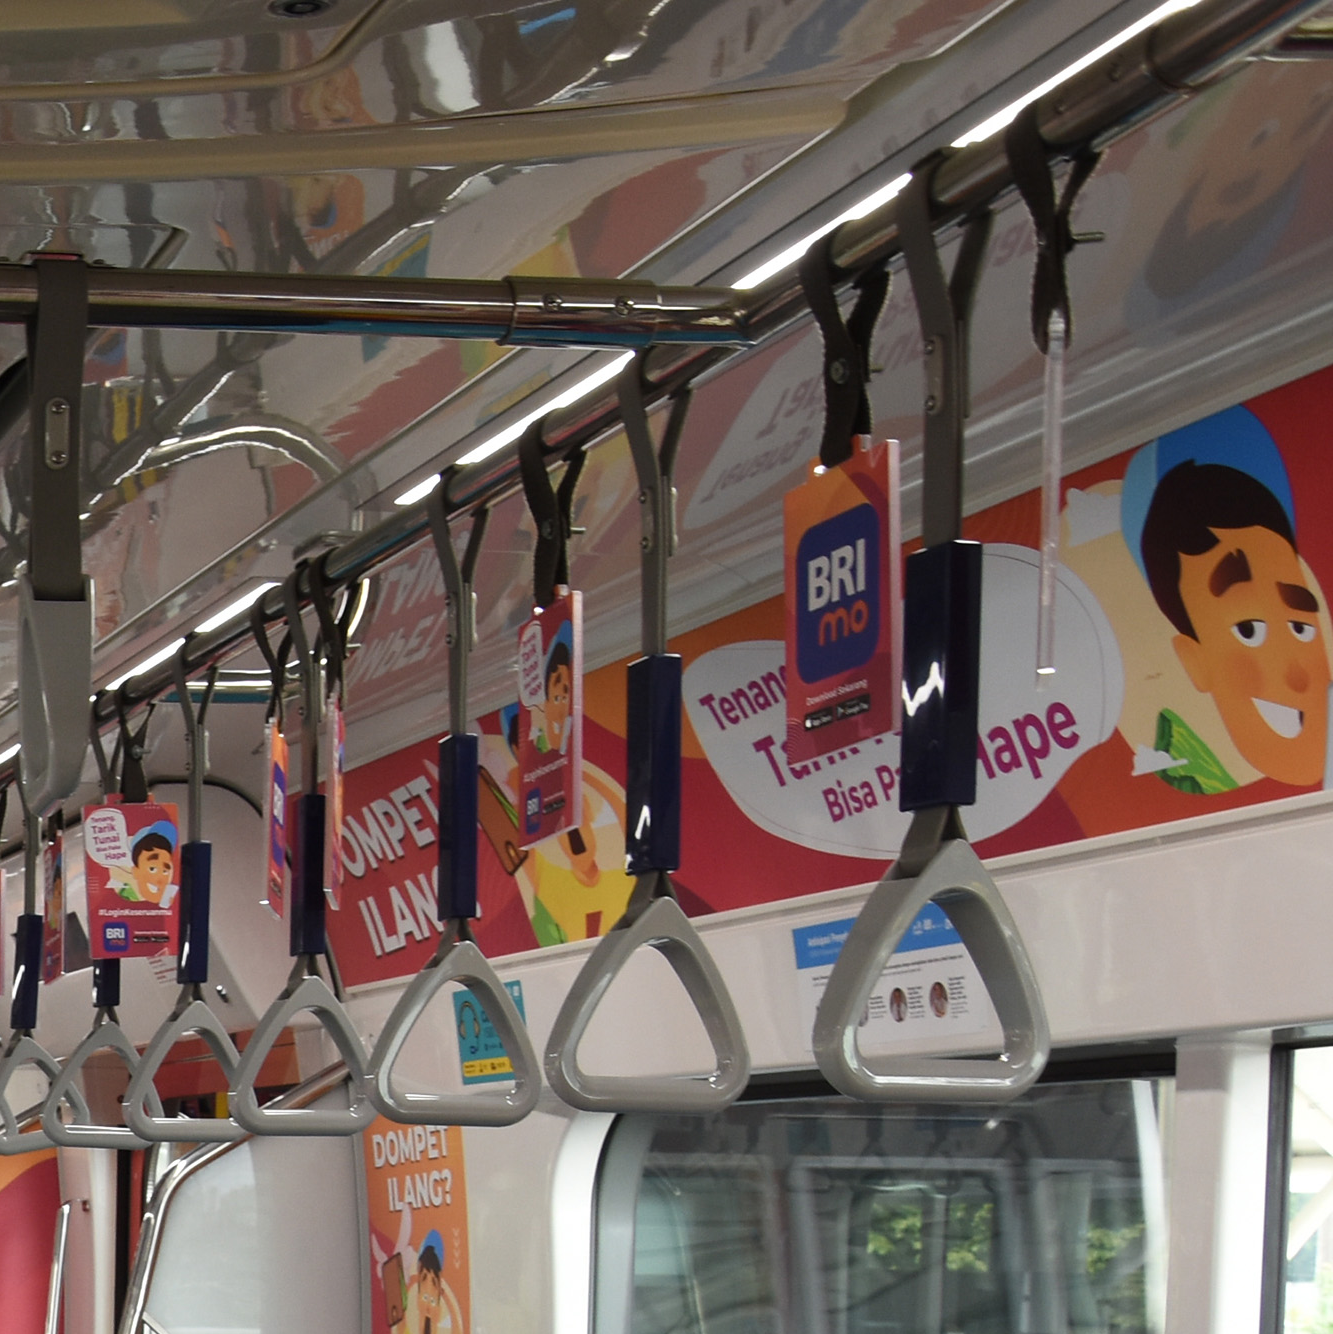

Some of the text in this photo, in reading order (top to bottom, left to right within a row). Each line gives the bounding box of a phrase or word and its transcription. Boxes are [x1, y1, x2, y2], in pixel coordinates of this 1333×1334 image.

[808, 538, 866, 612] BRI
[819, 600, 869, 647] mo
[699, 665, 787, 730] Tenan
[976, 701, 1081, 780] ape
[822, 773, 874, 822] Bisa
[91, 825, 117, 834] Tarik
[93, 834, 121, 845] Tunai
[340, 775, 440, 878] OMPET
[105, 851, 127, 862] Hape
[106, 928, 125, 939] BRI
[372, 1126, 448, 1169] DOMPET
[387, 1168, 453, 1212] ILANG?
